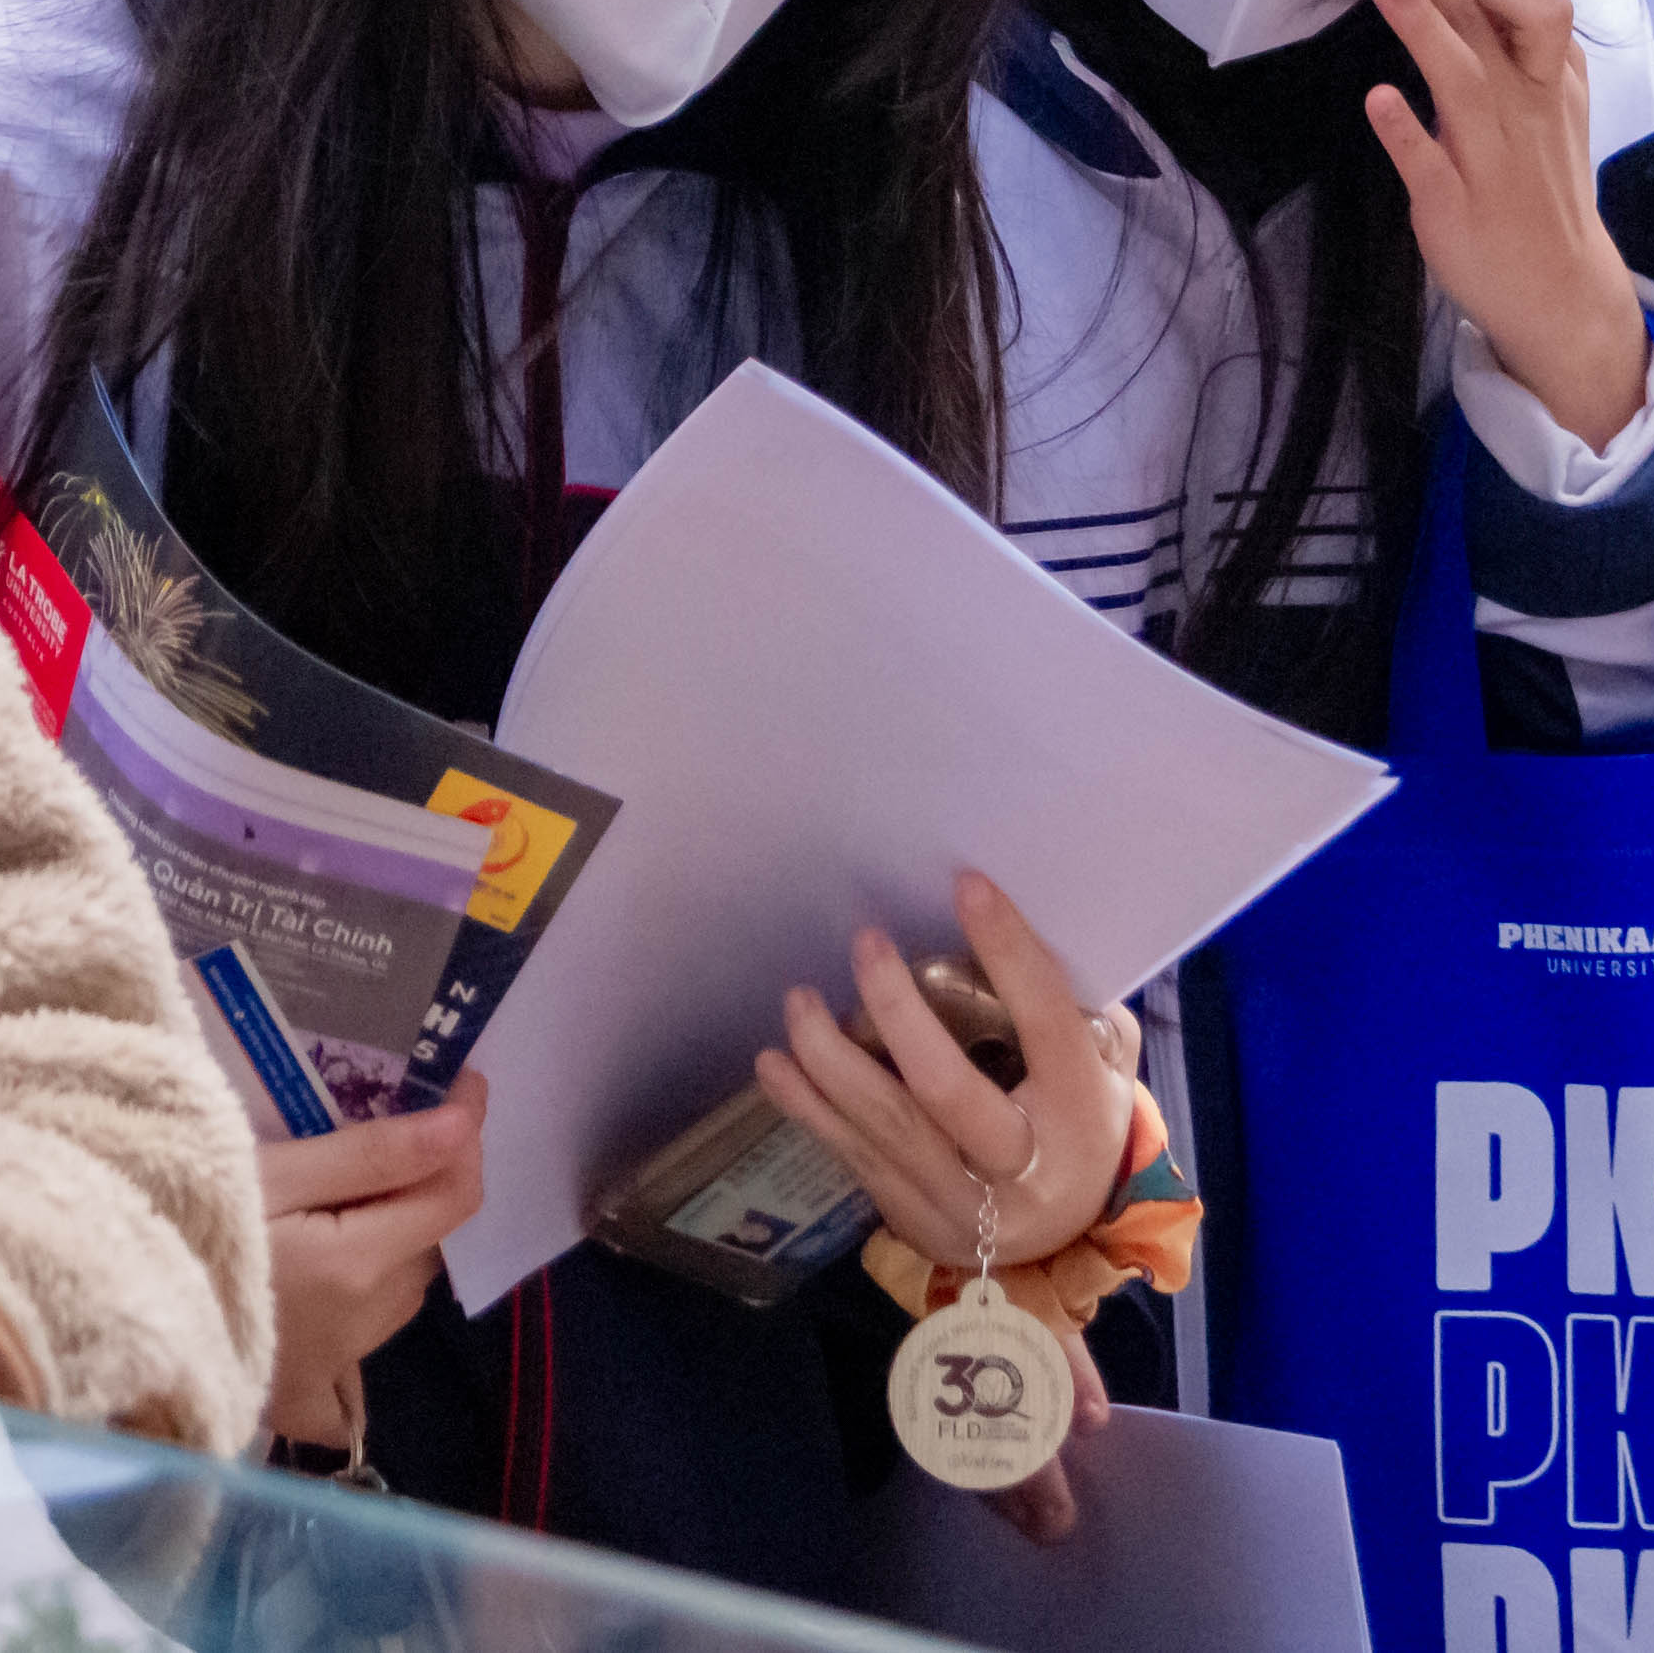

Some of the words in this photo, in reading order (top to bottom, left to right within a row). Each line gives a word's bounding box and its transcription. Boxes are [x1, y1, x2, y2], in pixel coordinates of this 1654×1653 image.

[6, 572, 62, 658] UNIVERSITY
[8, 550, 27, 587] LA
[28, 574, 68, 646] TROBE
[153, 859, 220, 909] Quản
[271, 903, 308, 933] Tài
[313, 918, 393, 955] Chính
